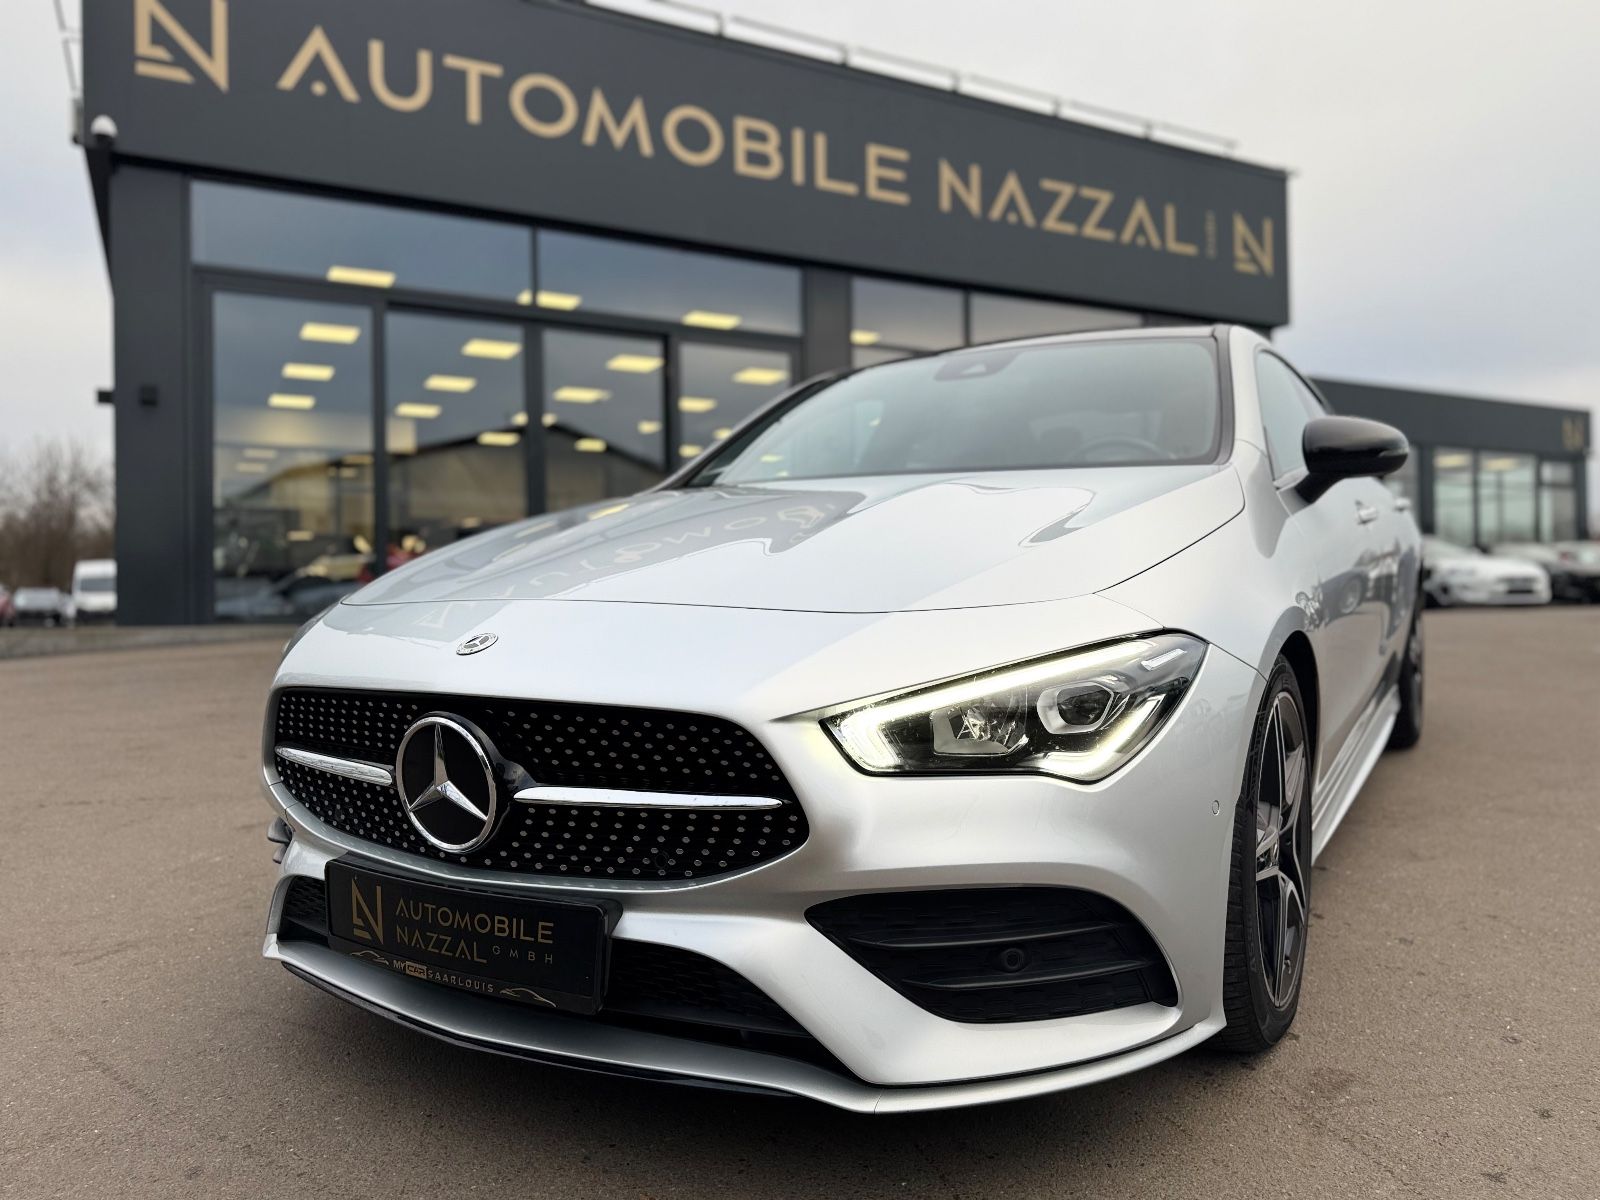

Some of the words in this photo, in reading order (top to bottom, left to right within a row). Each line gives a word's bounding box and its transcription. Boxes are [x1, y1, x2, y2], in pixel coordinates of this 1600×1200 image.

[277, 25, 910, 208] AUTOMOBILE
[937, 157, 1198, 257] NAZZAL
[395, 897, 554, 944] AUTOMOBILE
[396, 925, 488, 964] NAZZAL
[492, 945, 554, 965] GMBH
[427, 969, 494, 993] SAARLOUIS
